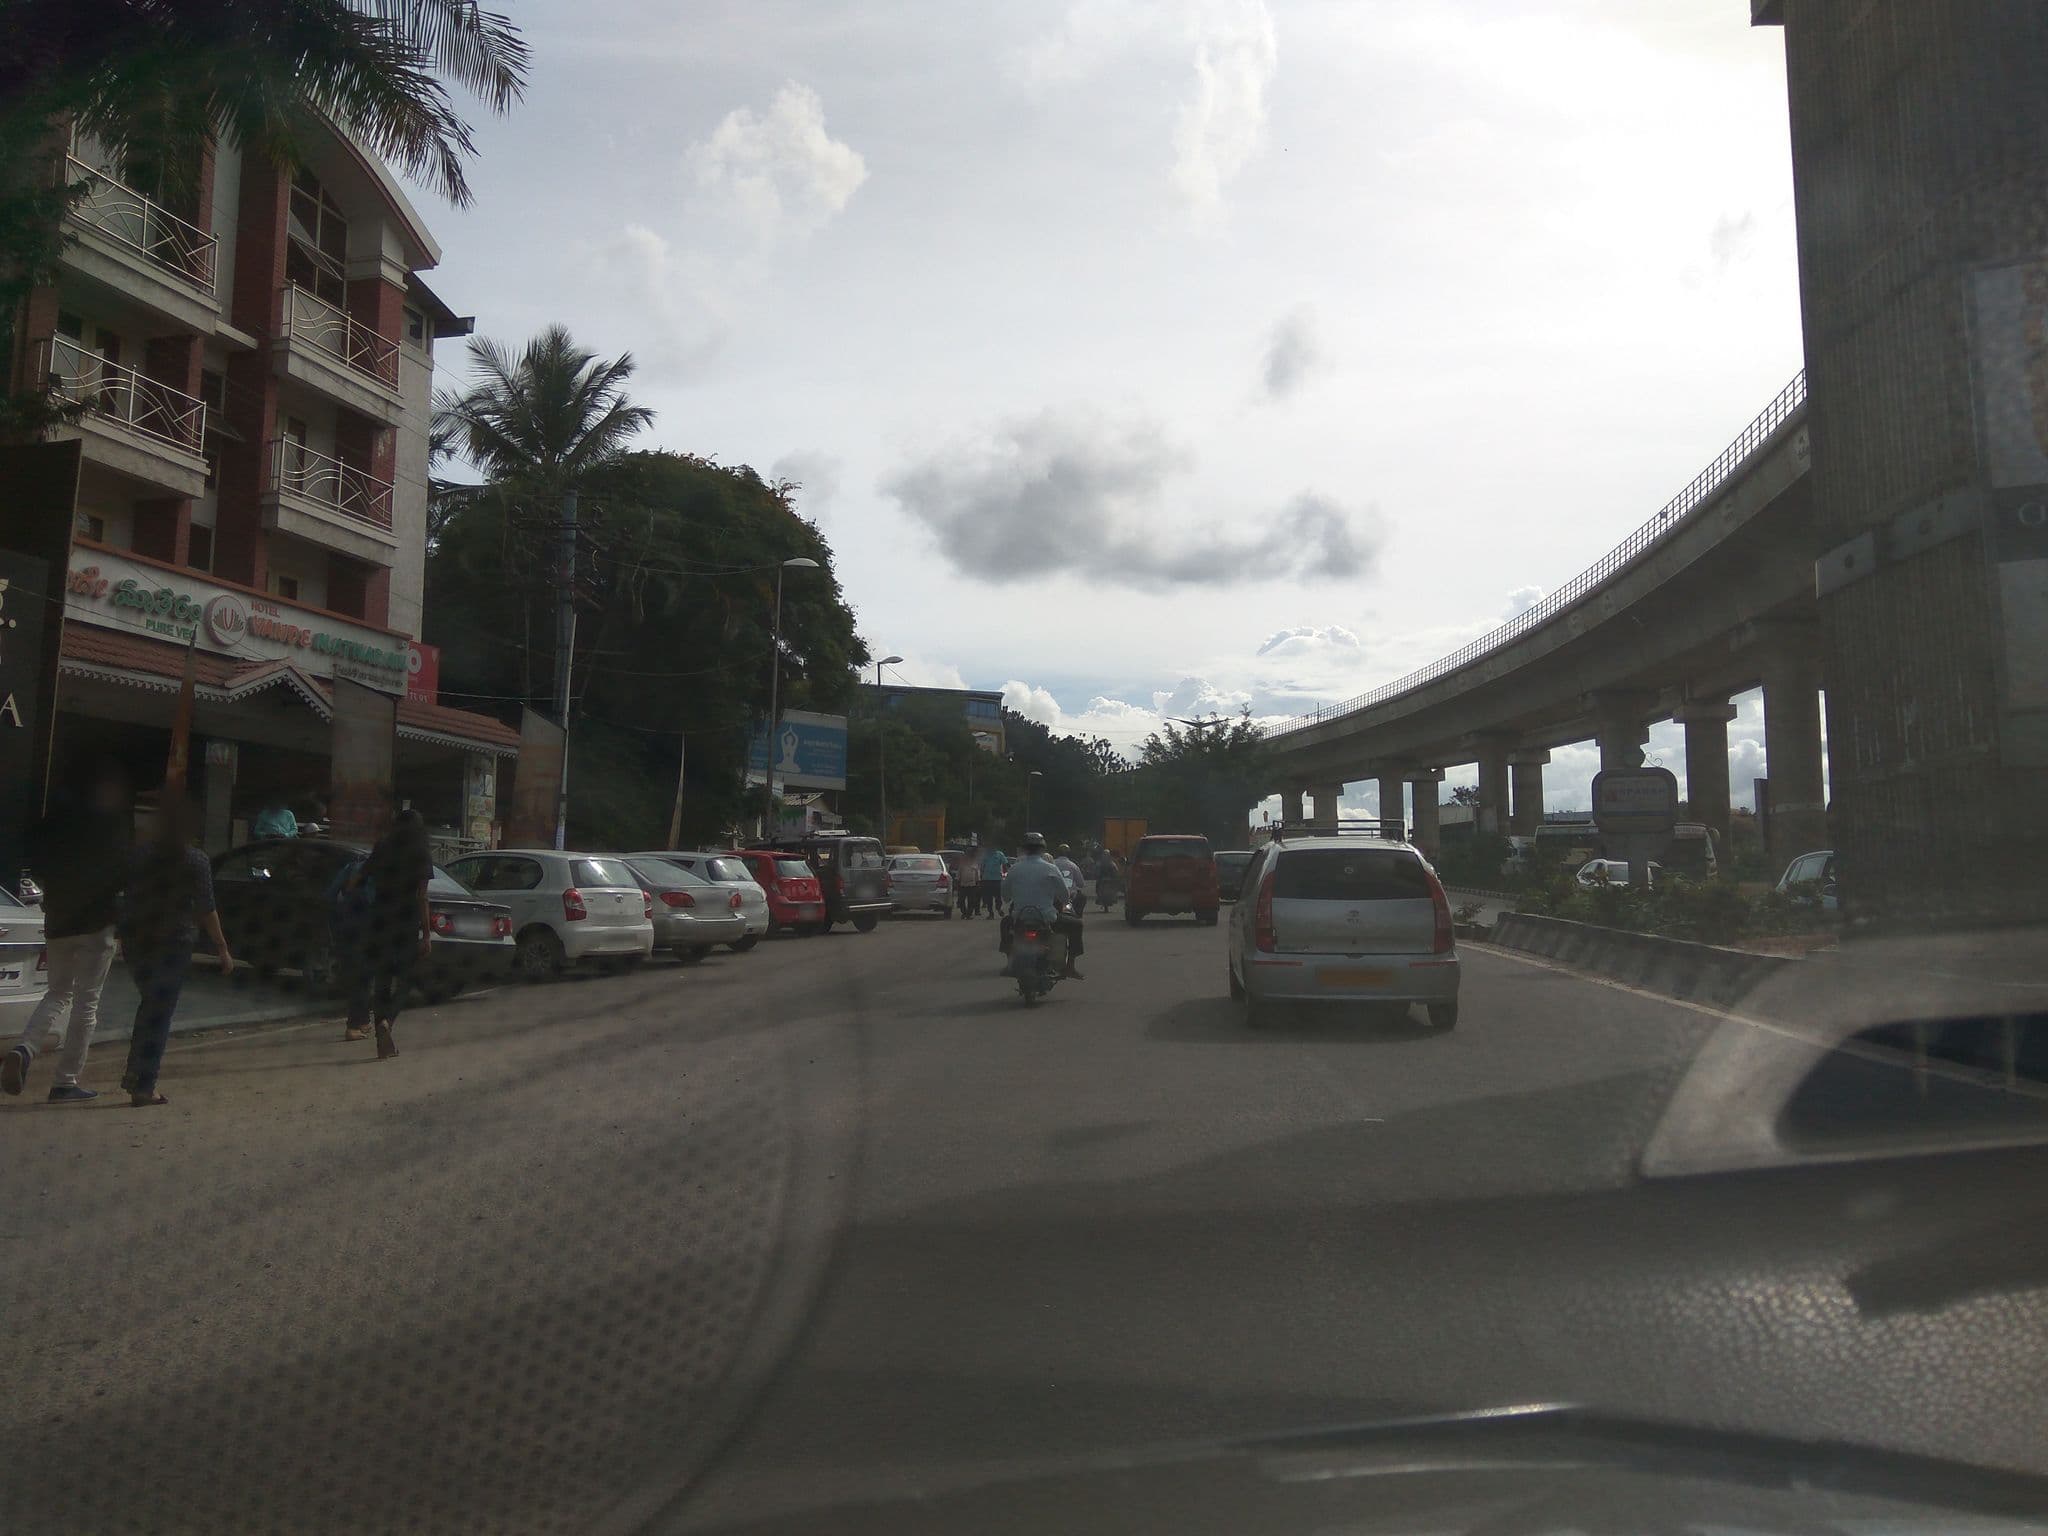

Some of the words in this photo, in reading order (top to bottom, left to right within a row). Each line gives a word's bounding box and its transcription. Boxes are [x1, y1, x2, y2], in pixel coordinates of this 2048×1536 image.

[251, 600, 280, 618] HOTEL
[145, 618, 174, 636] PURE
[252, 615, 312, 648] VANDE
